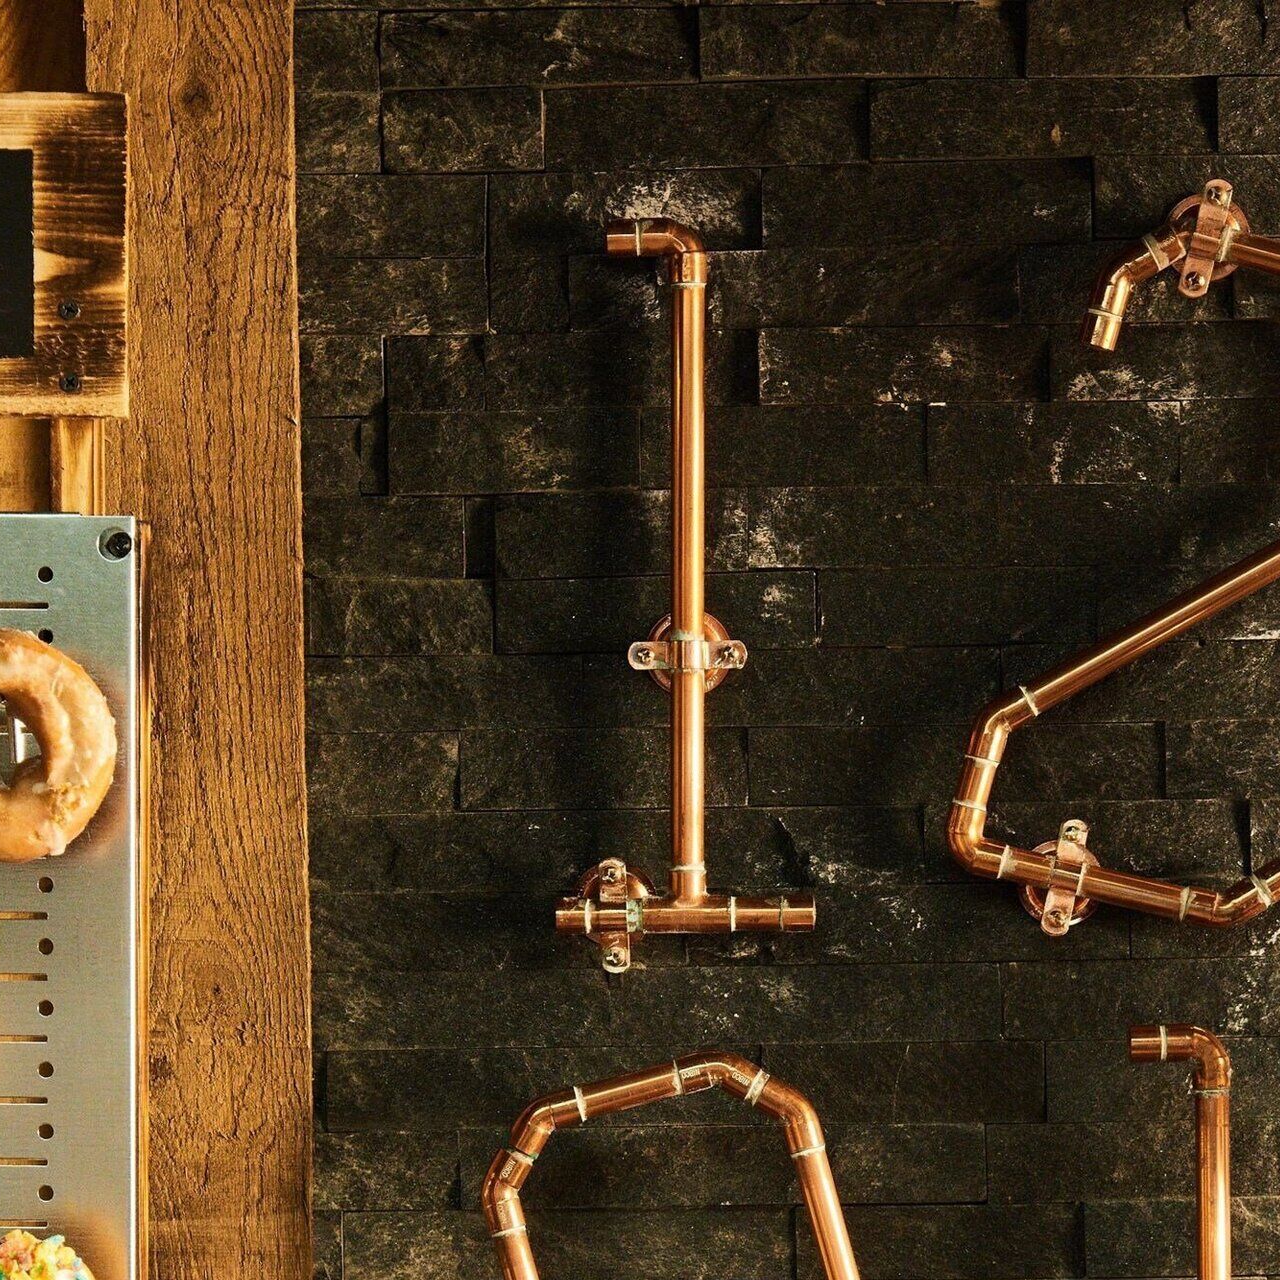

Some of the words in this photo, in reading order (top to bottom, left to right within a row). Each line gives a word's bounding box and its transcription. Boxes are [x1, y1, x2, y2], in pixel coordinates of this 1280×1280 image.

[682, 1068, 701, 1079] NIBCO
[731, 1070, 751, 1087] NIBCO
[501, 1160, 517, 1178] NIBCO
